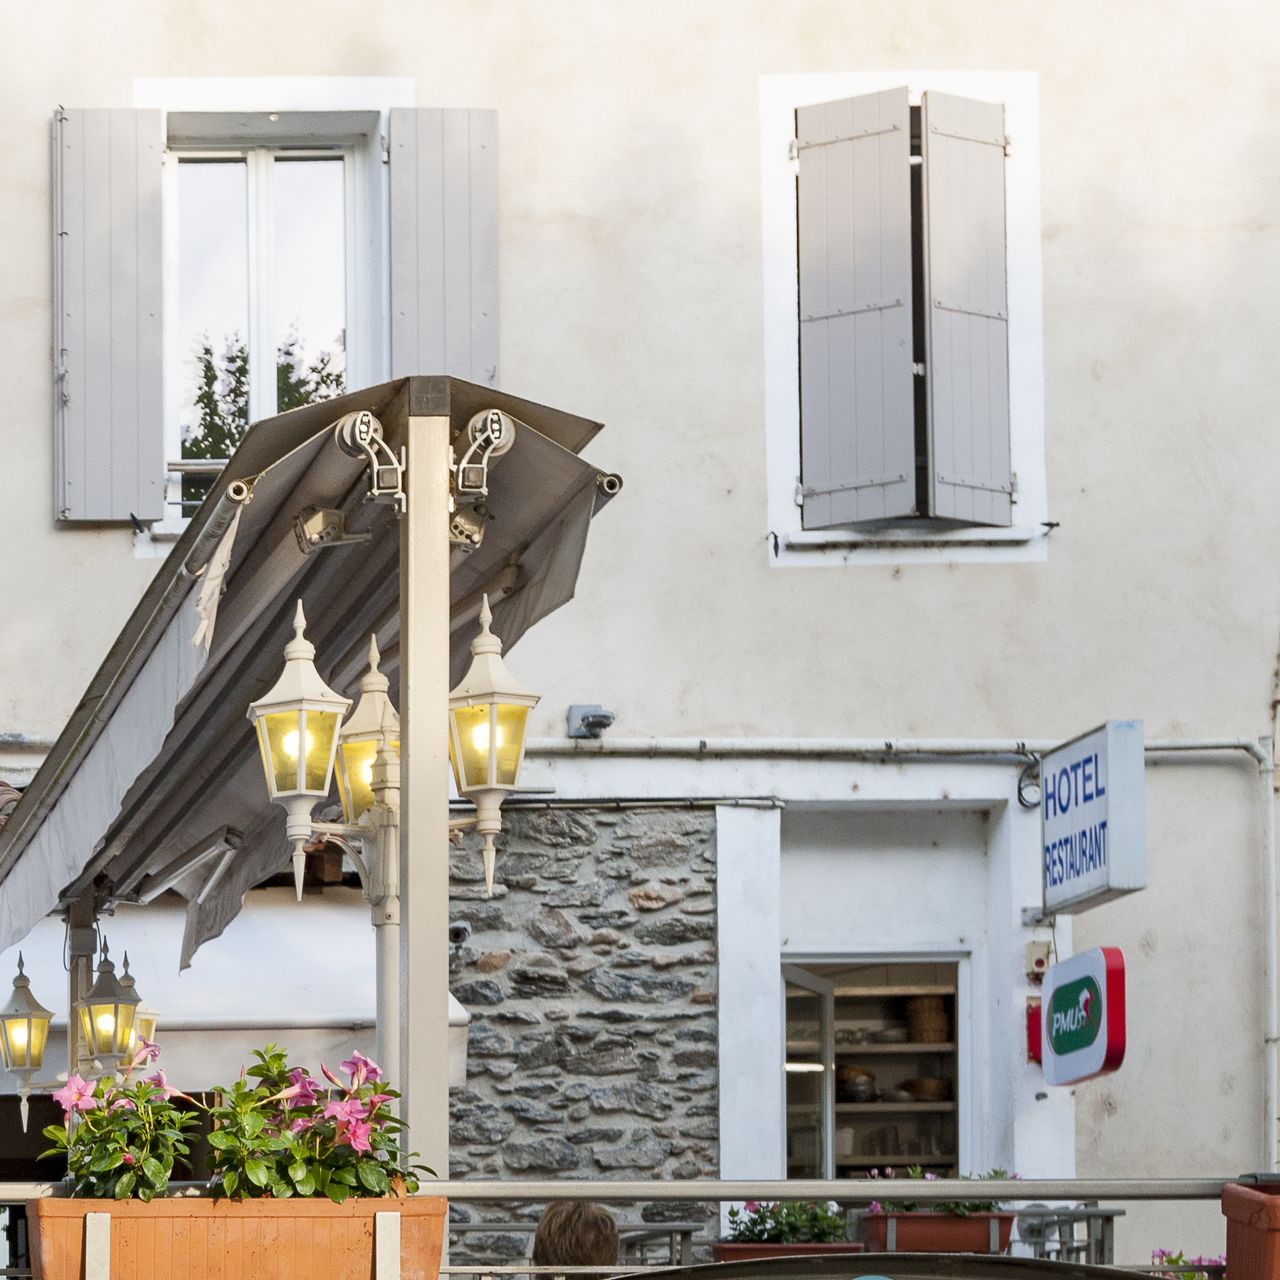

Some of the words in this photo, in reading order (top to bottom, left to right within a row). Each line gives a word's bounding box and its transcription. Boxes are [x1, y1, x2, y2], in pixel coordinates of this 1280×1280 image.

[1045, 753, 1105, 820] HOTEL
[1045, 820, 1107, 888] RESTAURANT
[1052, 1010, 1081, 1038] PMU
